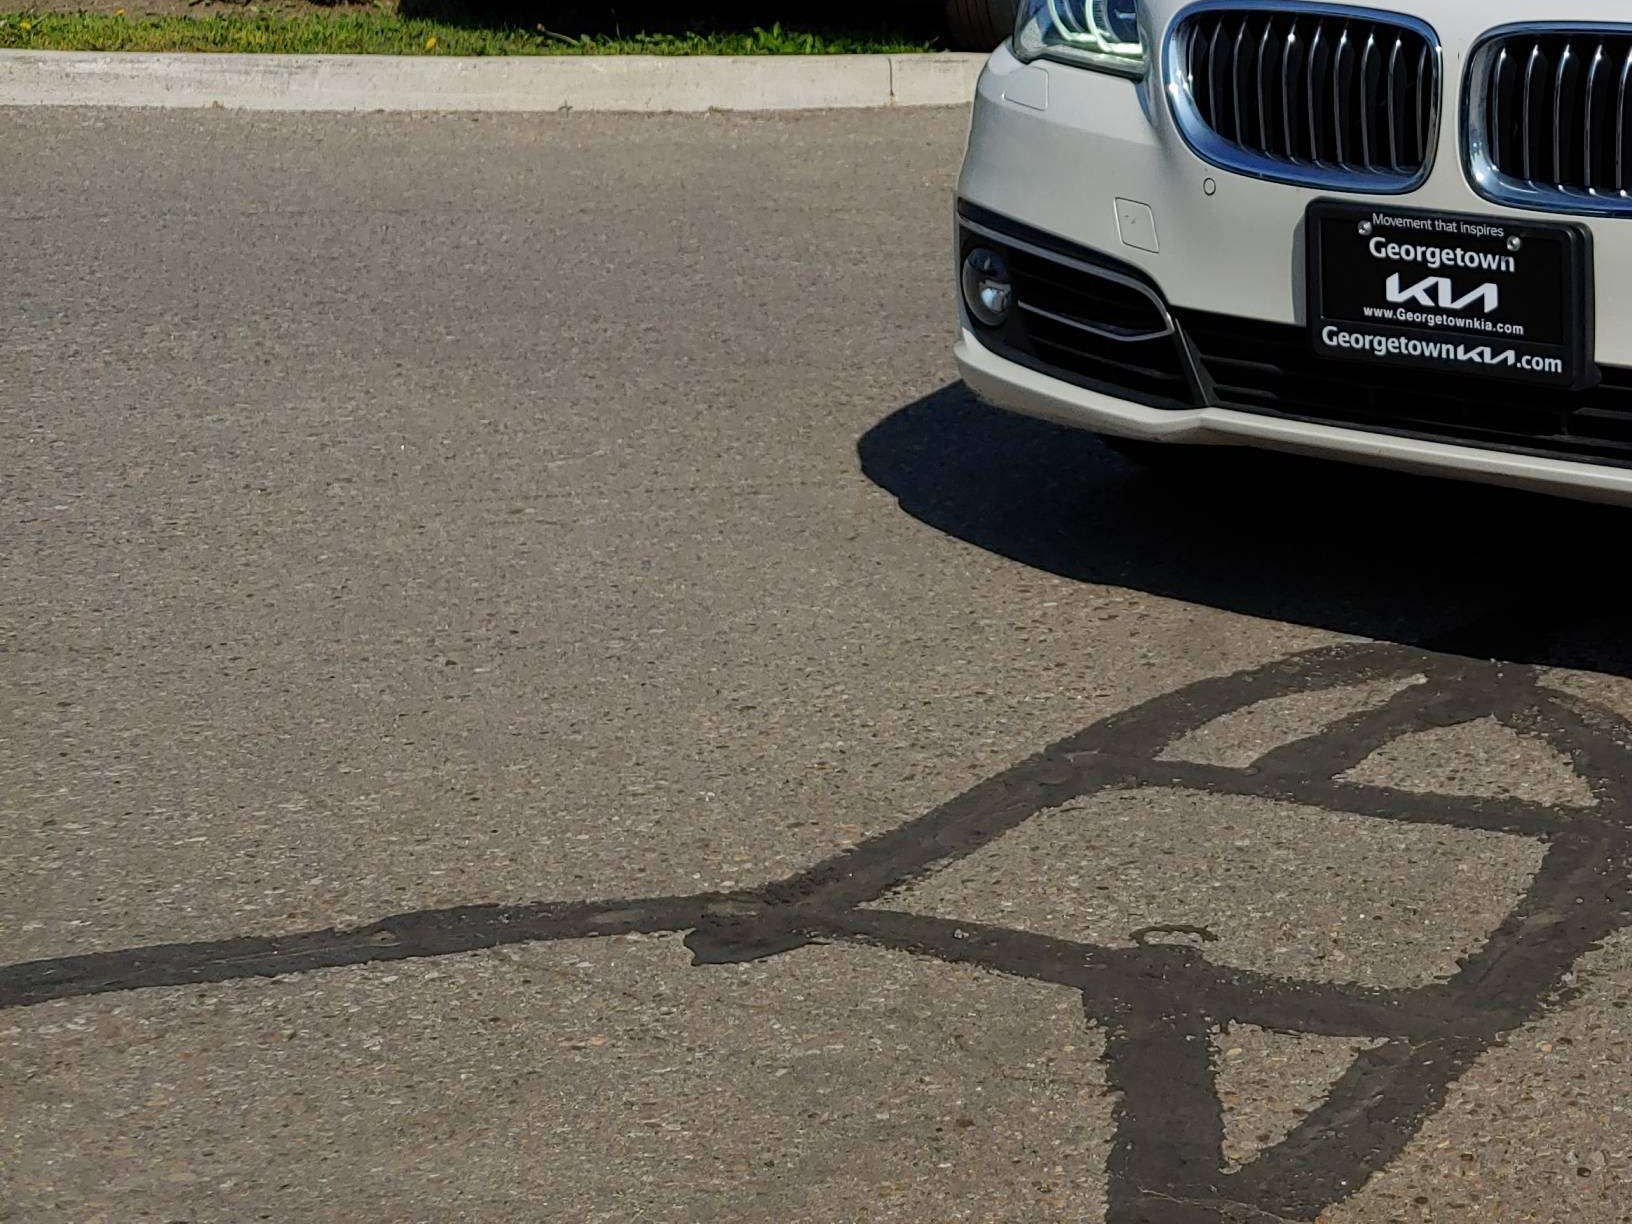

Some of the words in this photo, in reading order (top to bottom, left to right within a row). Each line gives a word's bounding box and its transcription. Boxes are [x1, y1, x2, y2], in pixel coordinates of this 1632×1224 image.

[1372, 213, 1432, 231] Movement
[1435, 218, 1457, 233] that
[1460, 221, 1504, 238] inspires
[1368, 236, 1515, 273] Georgetown
[1385, 272, 1498, 313] KIA
[1363, 305, 1524, 336] www.Georgetownkia.com
